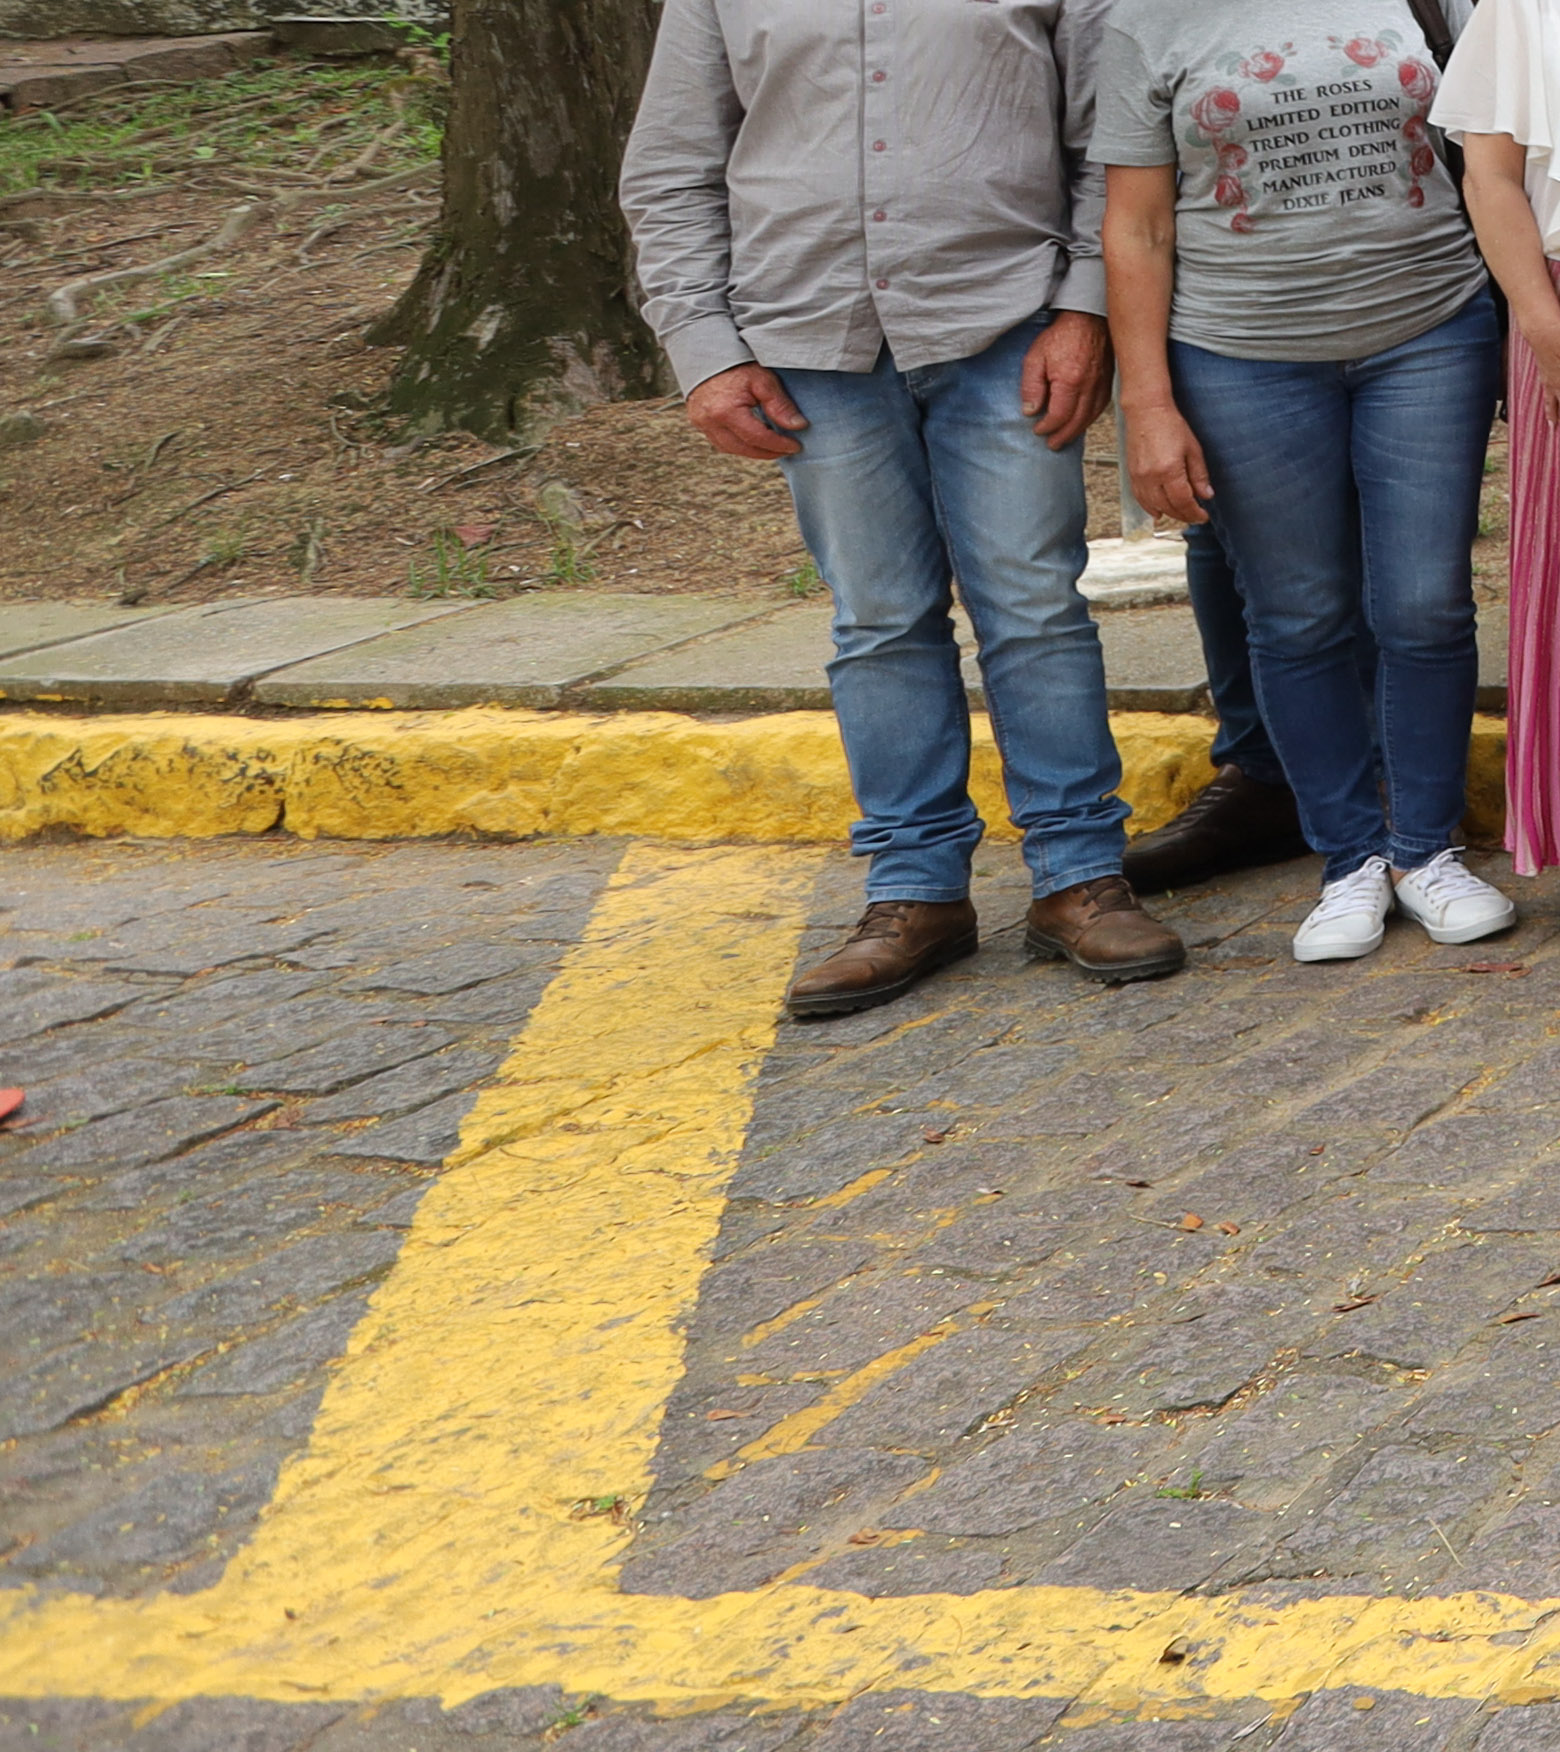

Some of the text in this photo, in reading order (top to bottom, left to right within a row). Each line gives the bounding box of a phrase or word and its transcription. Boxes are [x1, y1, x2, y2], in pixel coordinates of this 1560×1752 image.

[1270, 79, 1372, 106] THE ROSES
[1246, 97, 1400, 132] LIMITED EDITION
[1249, 117, 1401, 153] TREND CLOTHING
[1258, 139, 1398, 174] PREMIUM DENIM
[1262, 160, 1397, 194] MANUFACTURED
[1283, 183, 1385, 211] DIXIE JEANS
